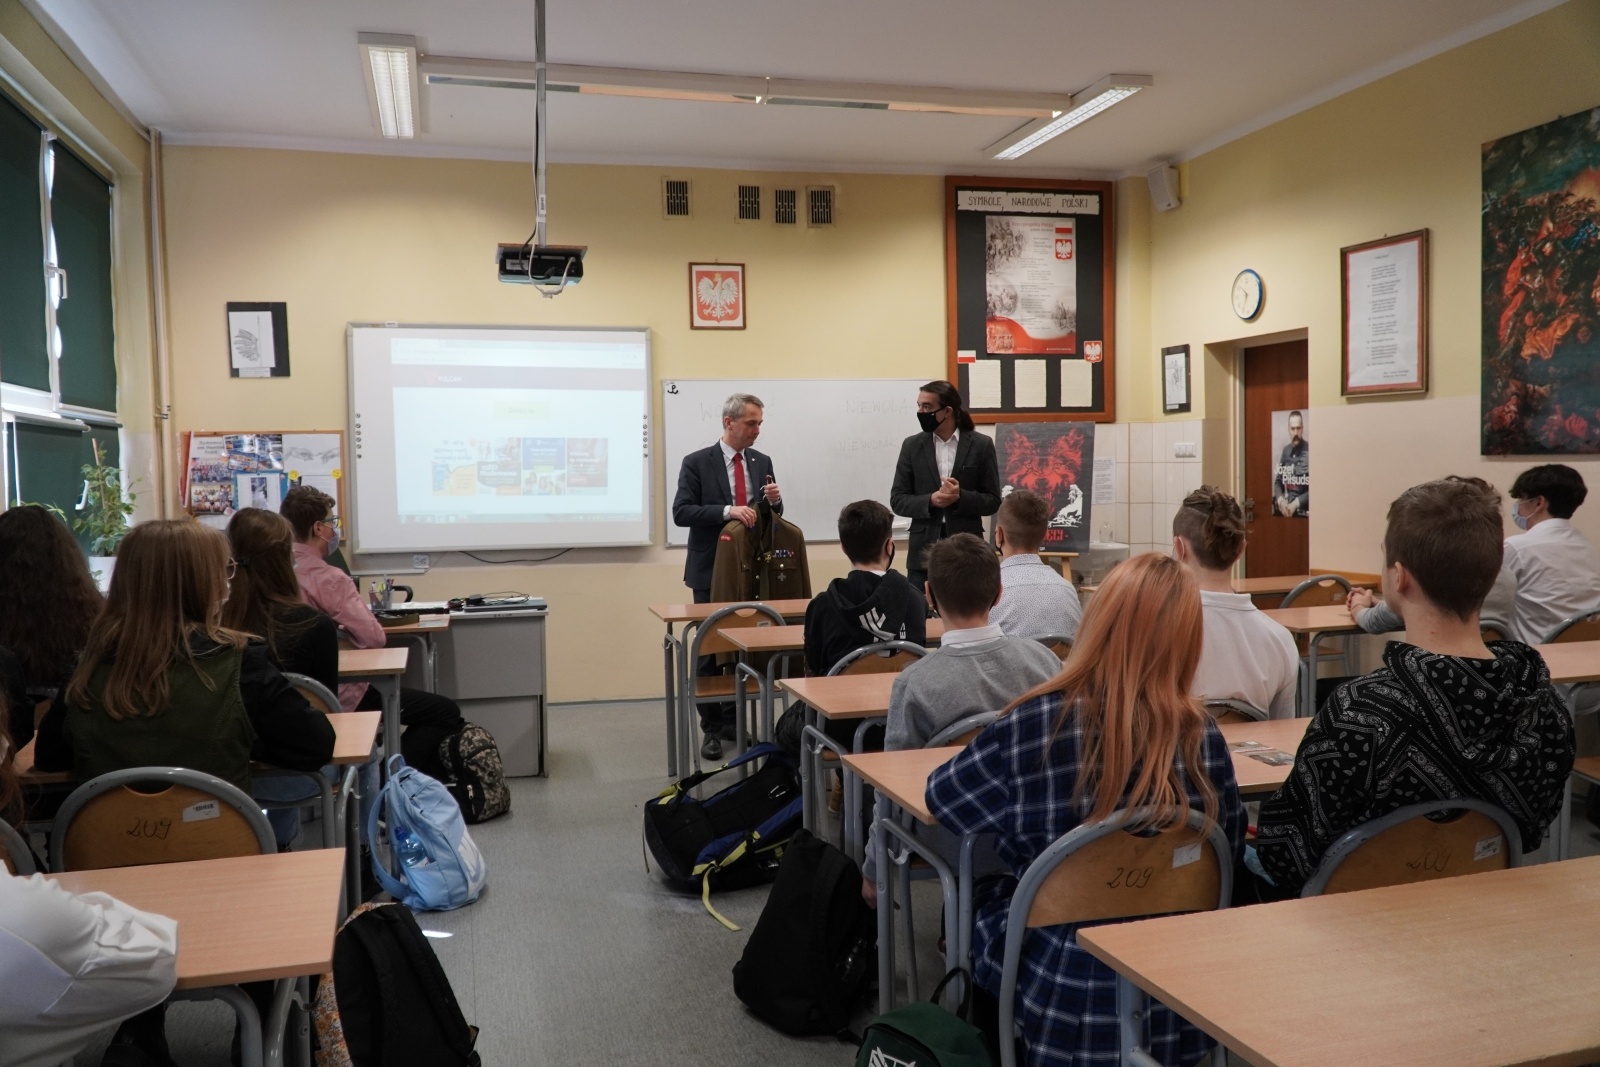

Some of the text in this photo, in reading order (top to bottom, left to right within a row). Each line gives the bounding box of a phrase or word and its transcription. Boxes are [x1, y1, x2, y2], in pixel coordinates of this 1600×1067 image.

[968, 196, 1089, 208] SYMBOLE NARODOWE POLSKI
[437, 375, 462, 383] VULCAN
[1275, 463, 1295, 475] Józef
[1106, 867, 1154, 889] 209
